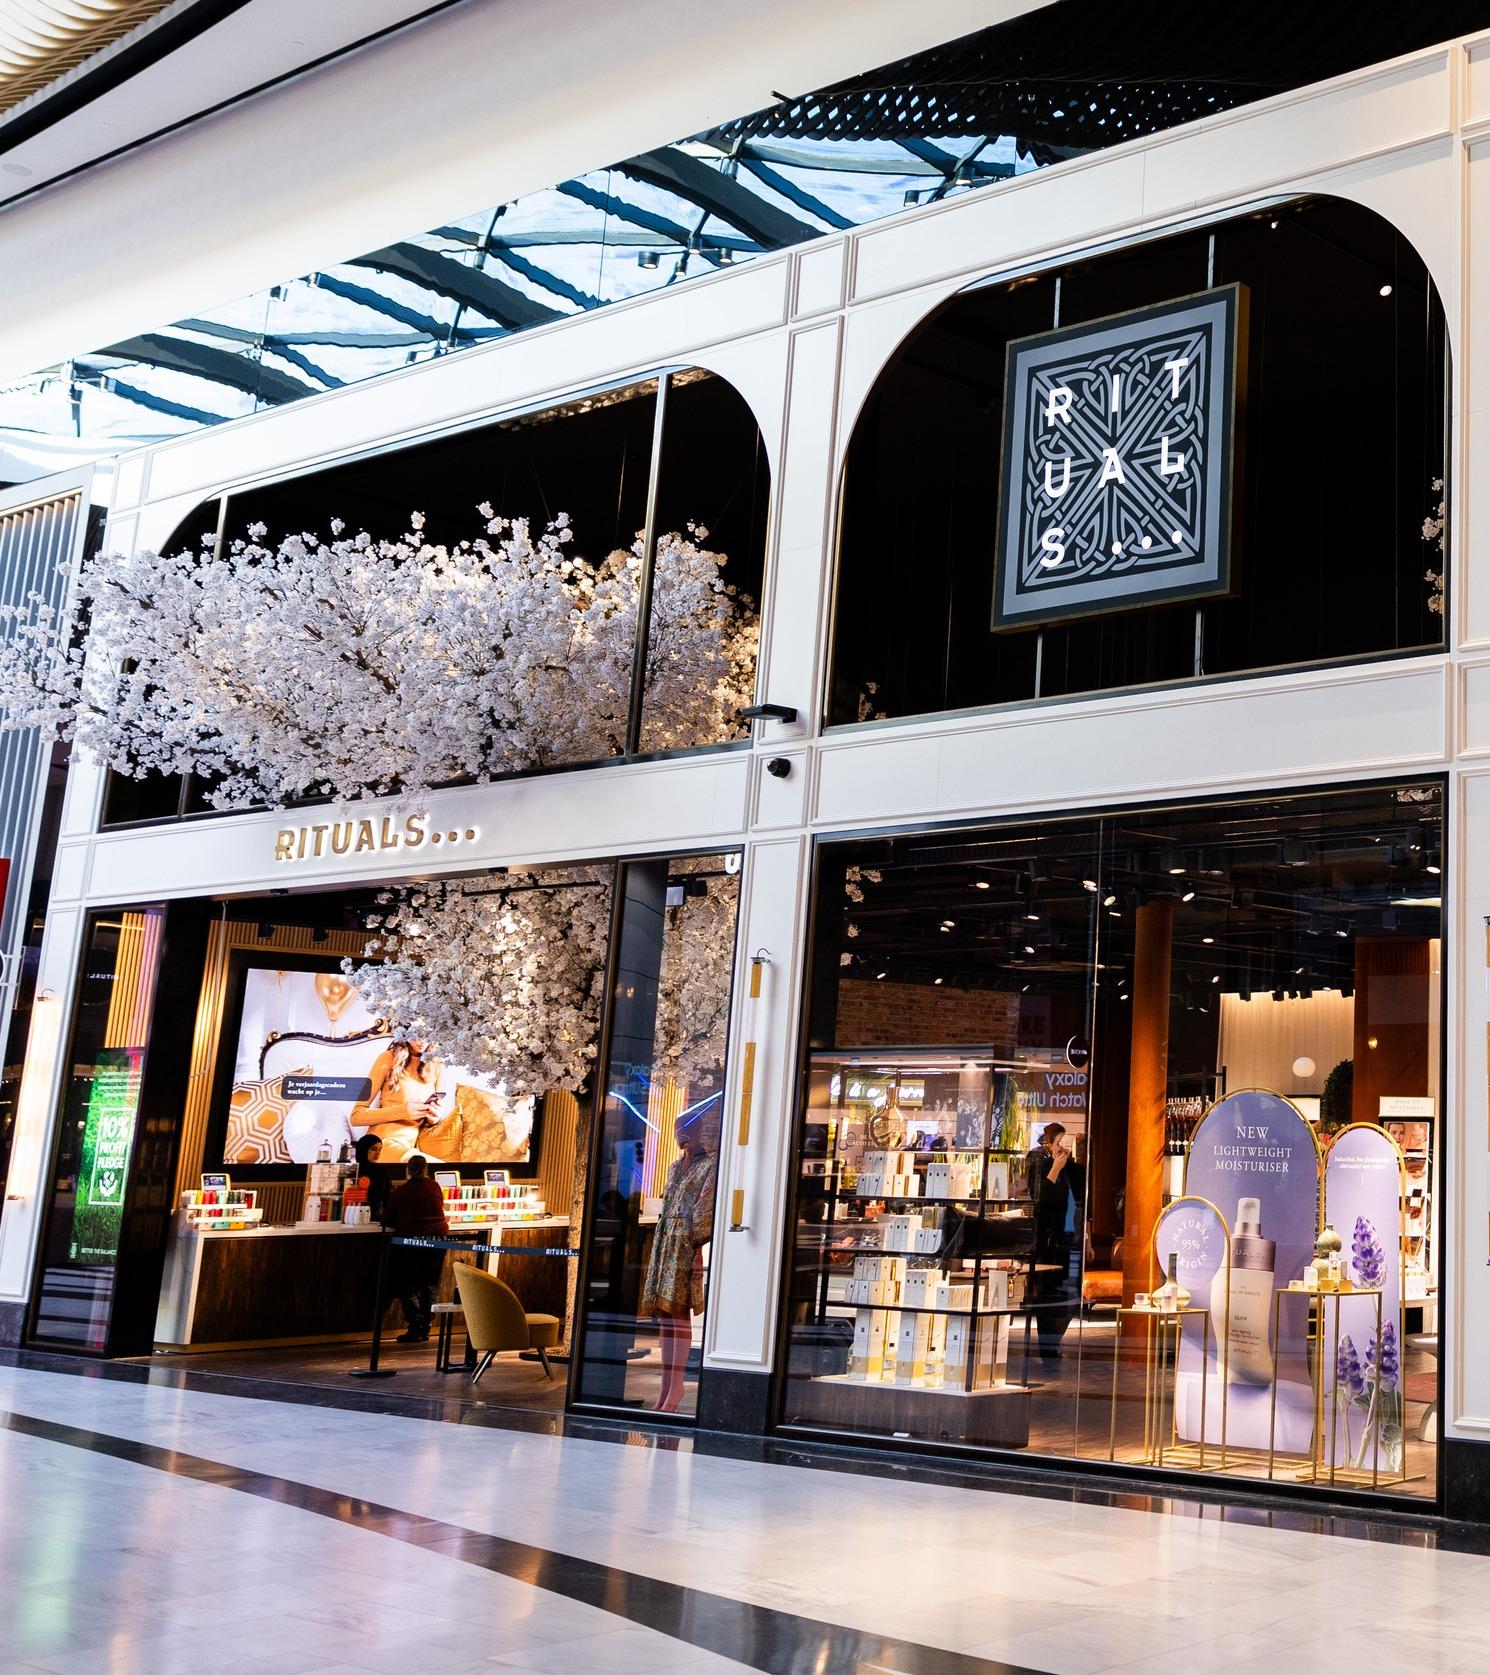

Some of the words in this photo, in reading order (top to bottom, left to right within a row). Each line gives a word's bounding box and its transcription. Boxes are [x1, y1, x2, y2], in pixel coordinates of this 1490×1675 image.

[274, 813, 476, 861] RITUALS...
[101, 1116, 130, 1139] 10%
[1236, 1126, 1270, 1139] NEW
[1213, 1145, 1293, 1158] LIGHTWEIGHT
[1215, 1160, 1290, 1173] MOISTURISER
[1172, 1219, 1209, 1244] NATURAL
[1181, 1239, 1201, 1250] 95%
